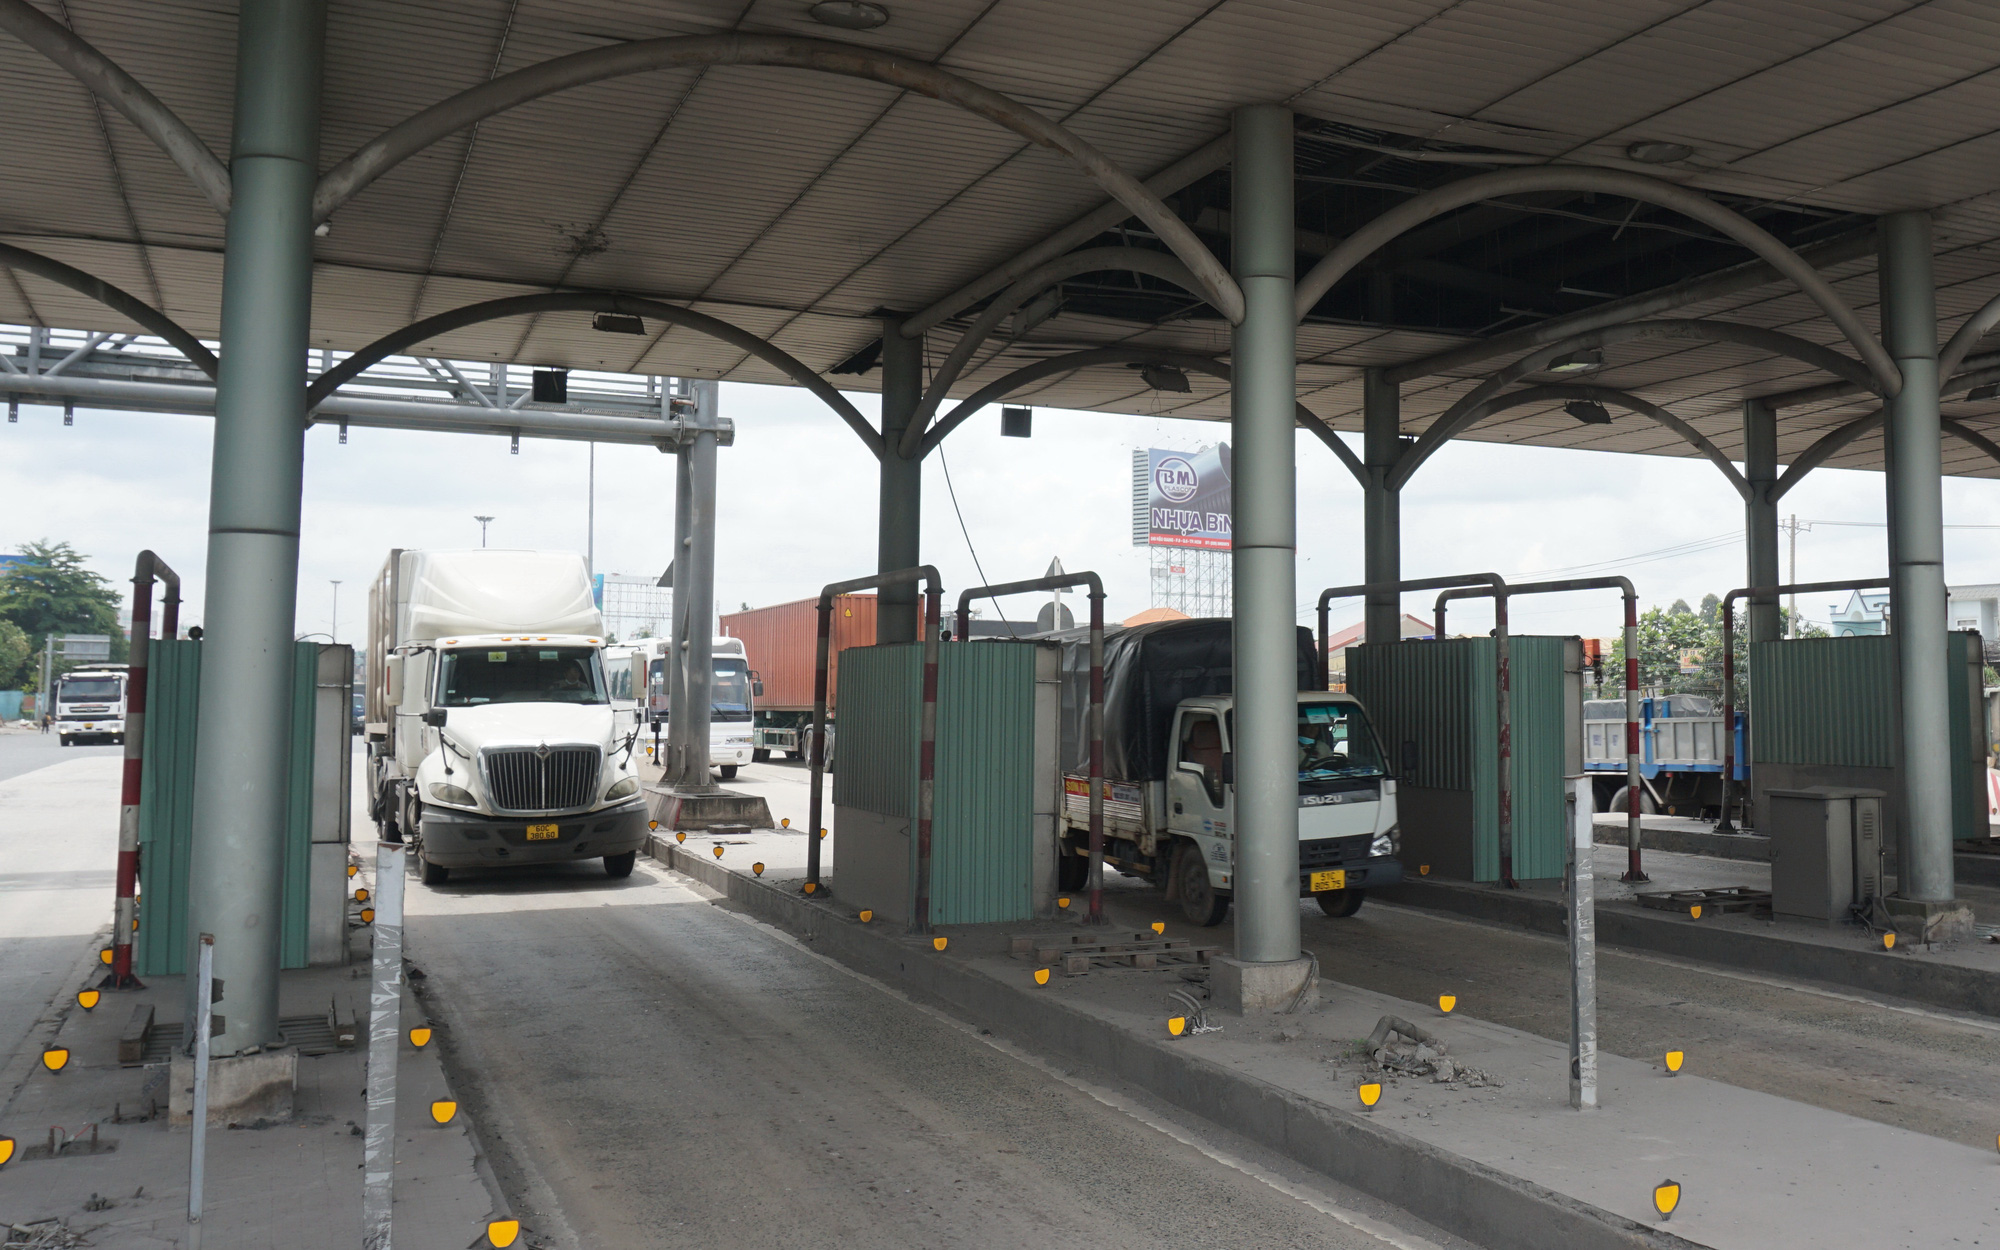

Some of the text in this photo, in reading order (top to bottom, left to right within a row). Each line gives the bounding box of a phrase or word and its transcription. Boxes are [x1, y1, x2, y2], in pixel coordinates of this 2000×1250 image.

[1152, 507, 1204, 536] NHỰA
[1303, 794, 1343, 805] ISUZU
[1320, 871, 1335, 881] 51C
